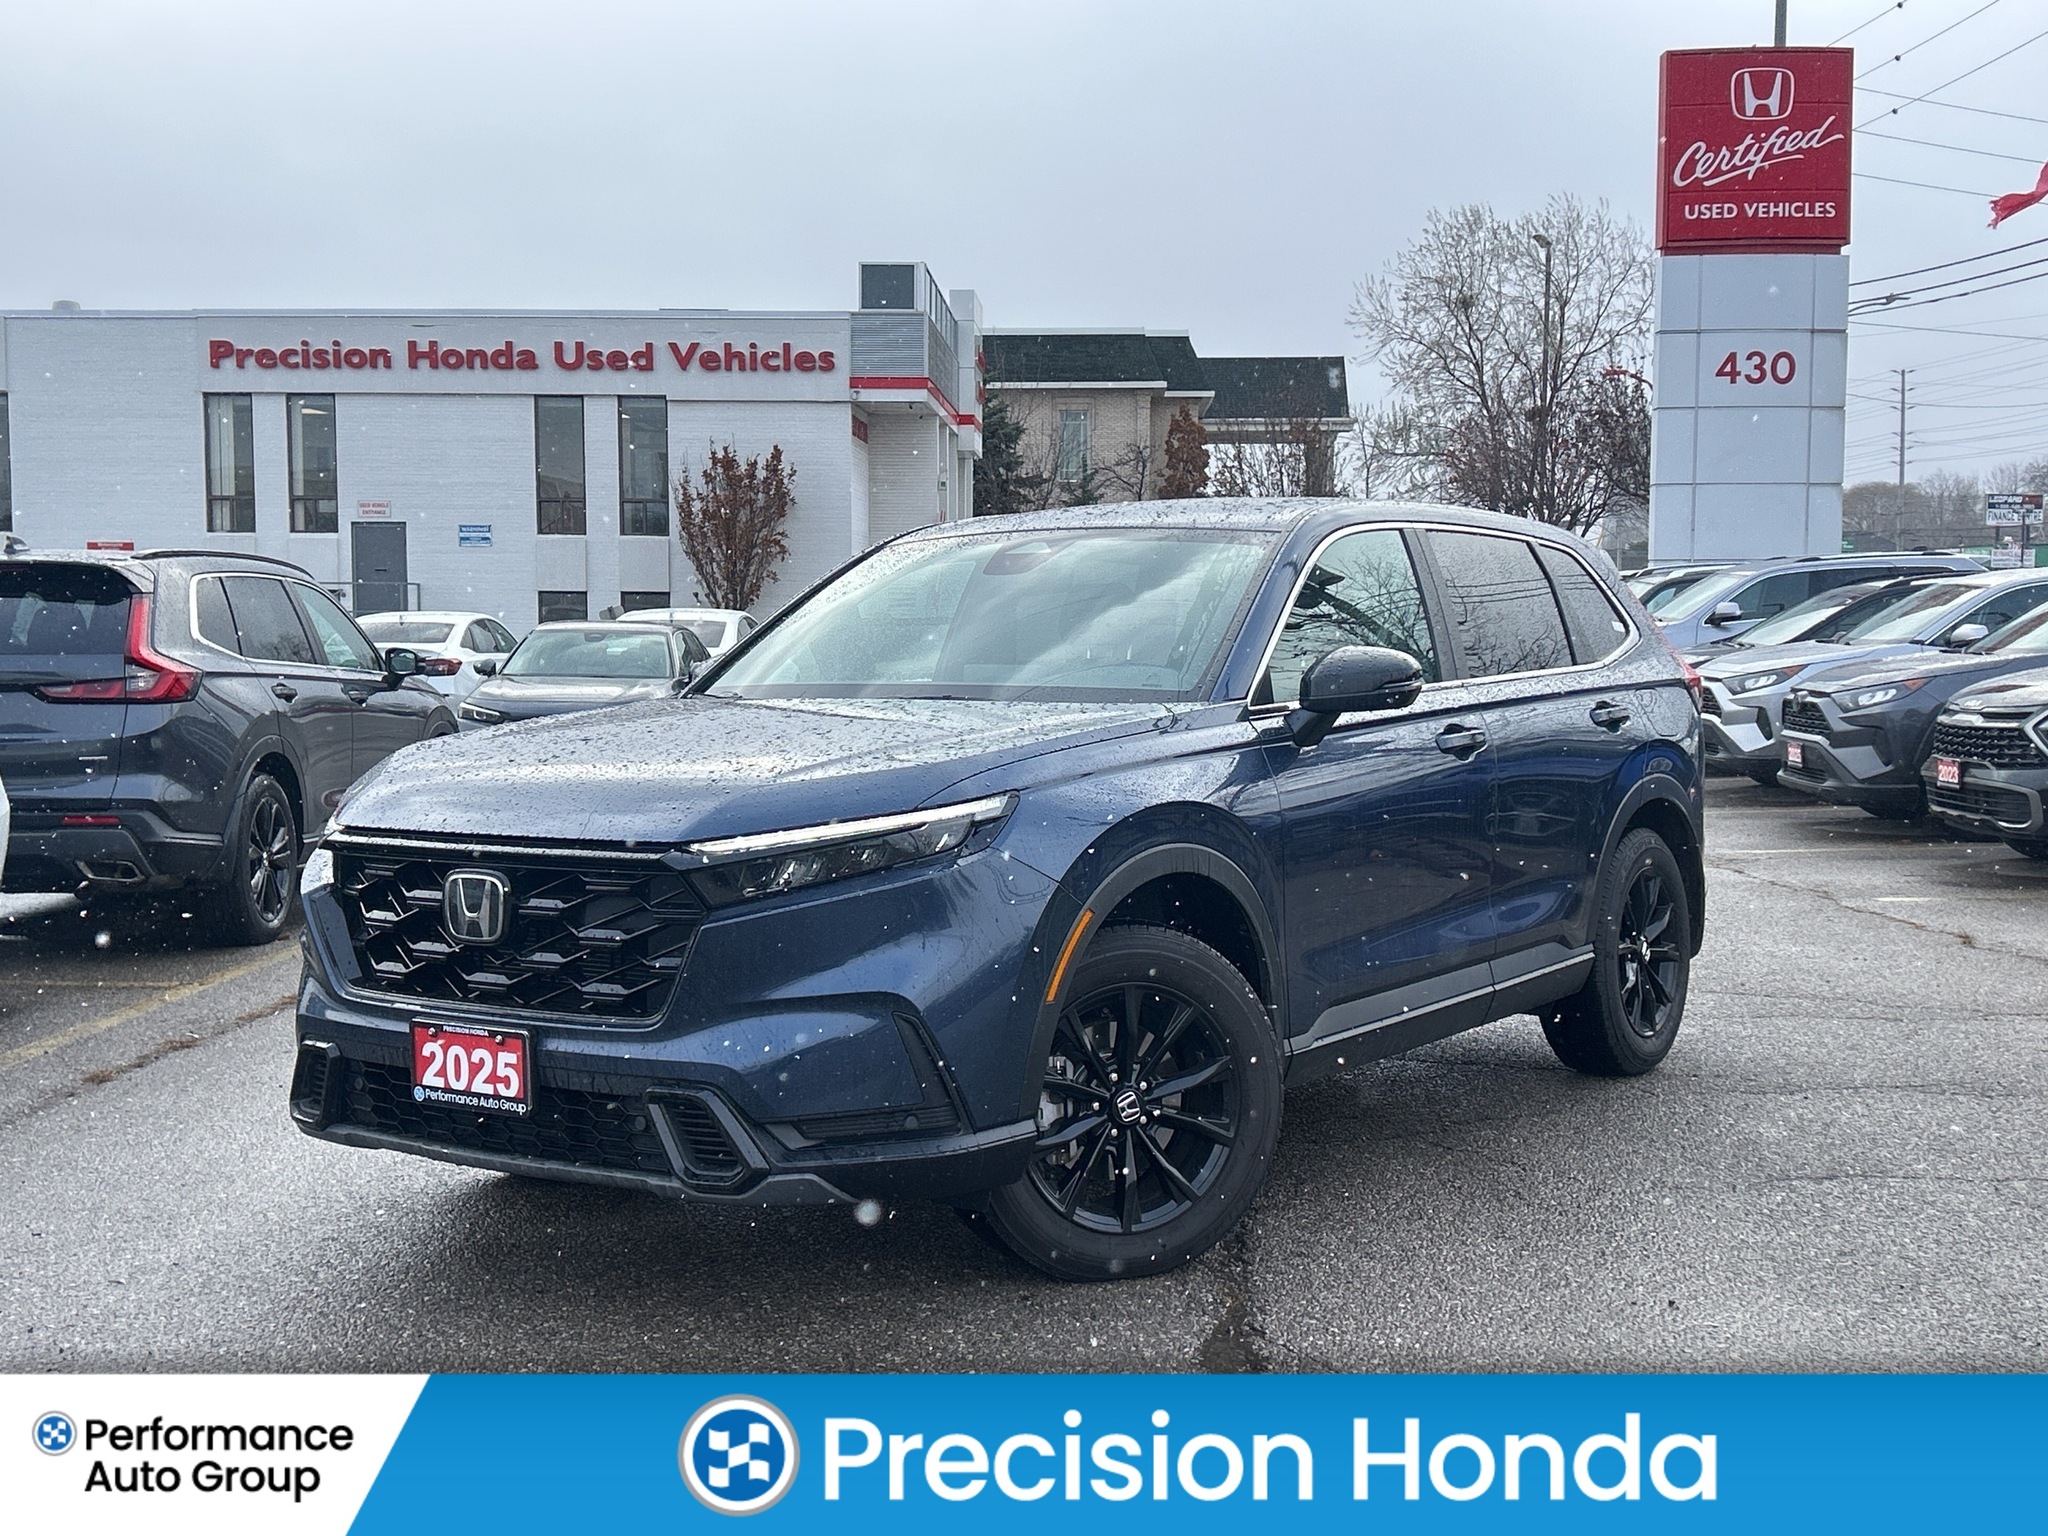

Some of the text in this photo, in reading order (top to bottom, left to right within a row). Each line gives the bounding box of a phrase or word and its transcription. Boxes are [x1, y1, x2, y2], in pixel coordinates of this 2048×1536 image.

[1673, 115, 1845, 186] Certified
[1684, 201, 1836, 219] USED VEHICLES
[208, 339, 835, 372] Precision Honda Used Vehicles
[1715, 350, 1796, 385] 430
[443, 1026, 489, 1037] PRECISION HONDA
[421, 1042, 520, 1098] 2025
[425, 1088, 527, 1116] Performance Auto Group
